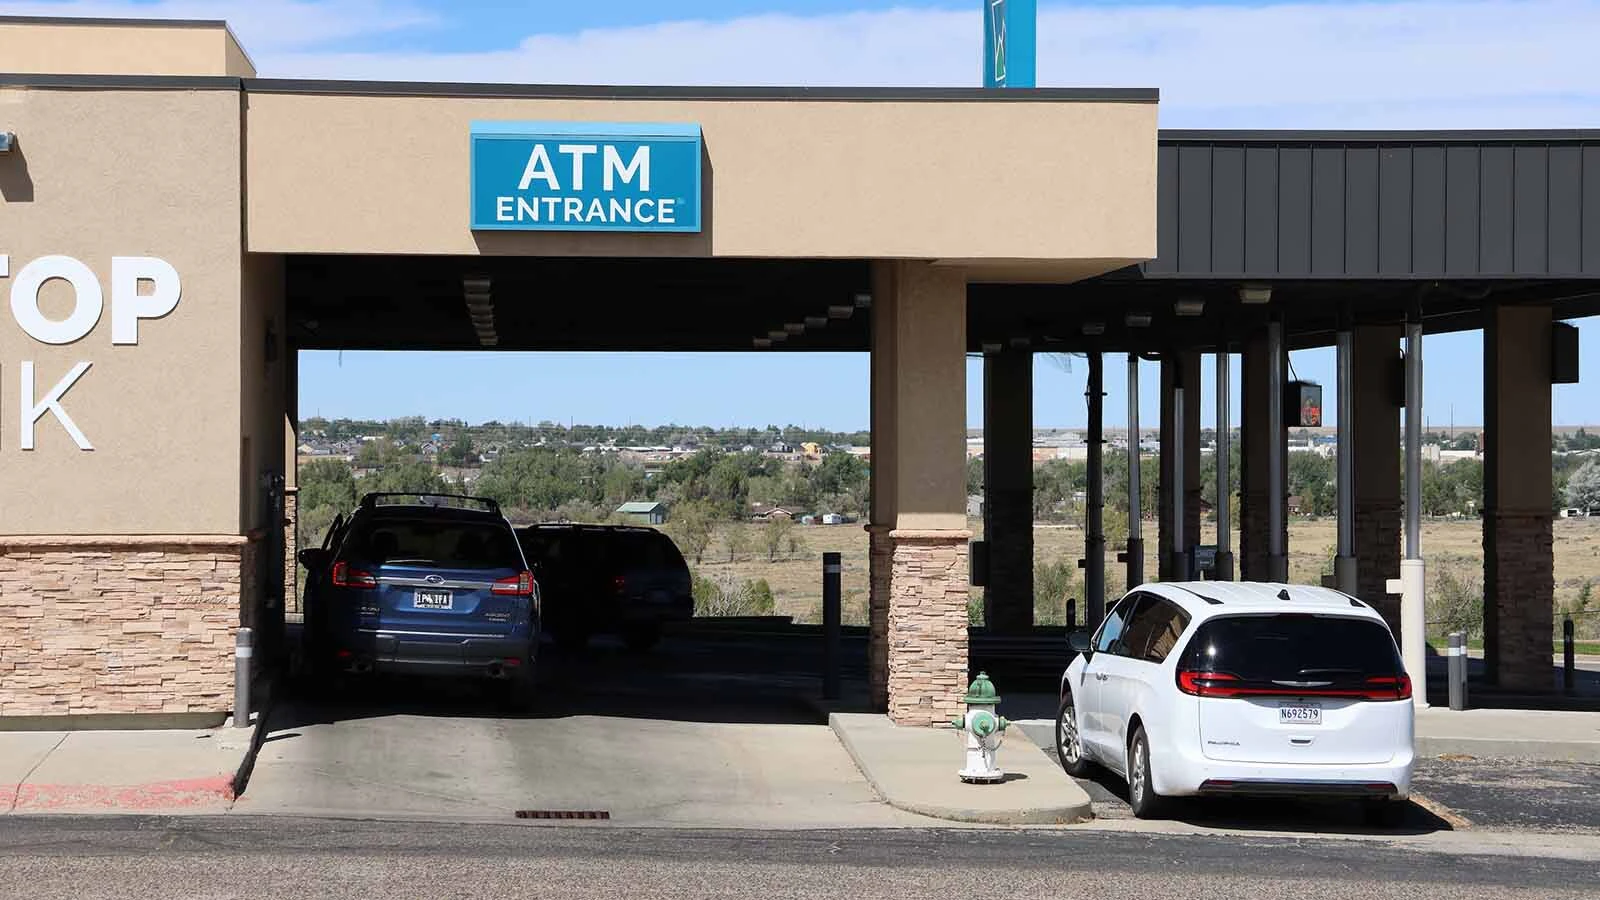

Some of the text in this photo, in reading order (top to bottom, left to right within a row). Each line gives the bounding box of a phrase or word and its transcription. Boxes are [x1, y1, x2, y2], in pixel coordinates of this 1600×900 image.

[517, 144, 650, 192] ATM
[496, 196, 676, 224] ENTRANCE
[0, 254, 182, 346] OP
[20, 360, 95, 451] K
[1281, 708, 1319, 719] N692579
